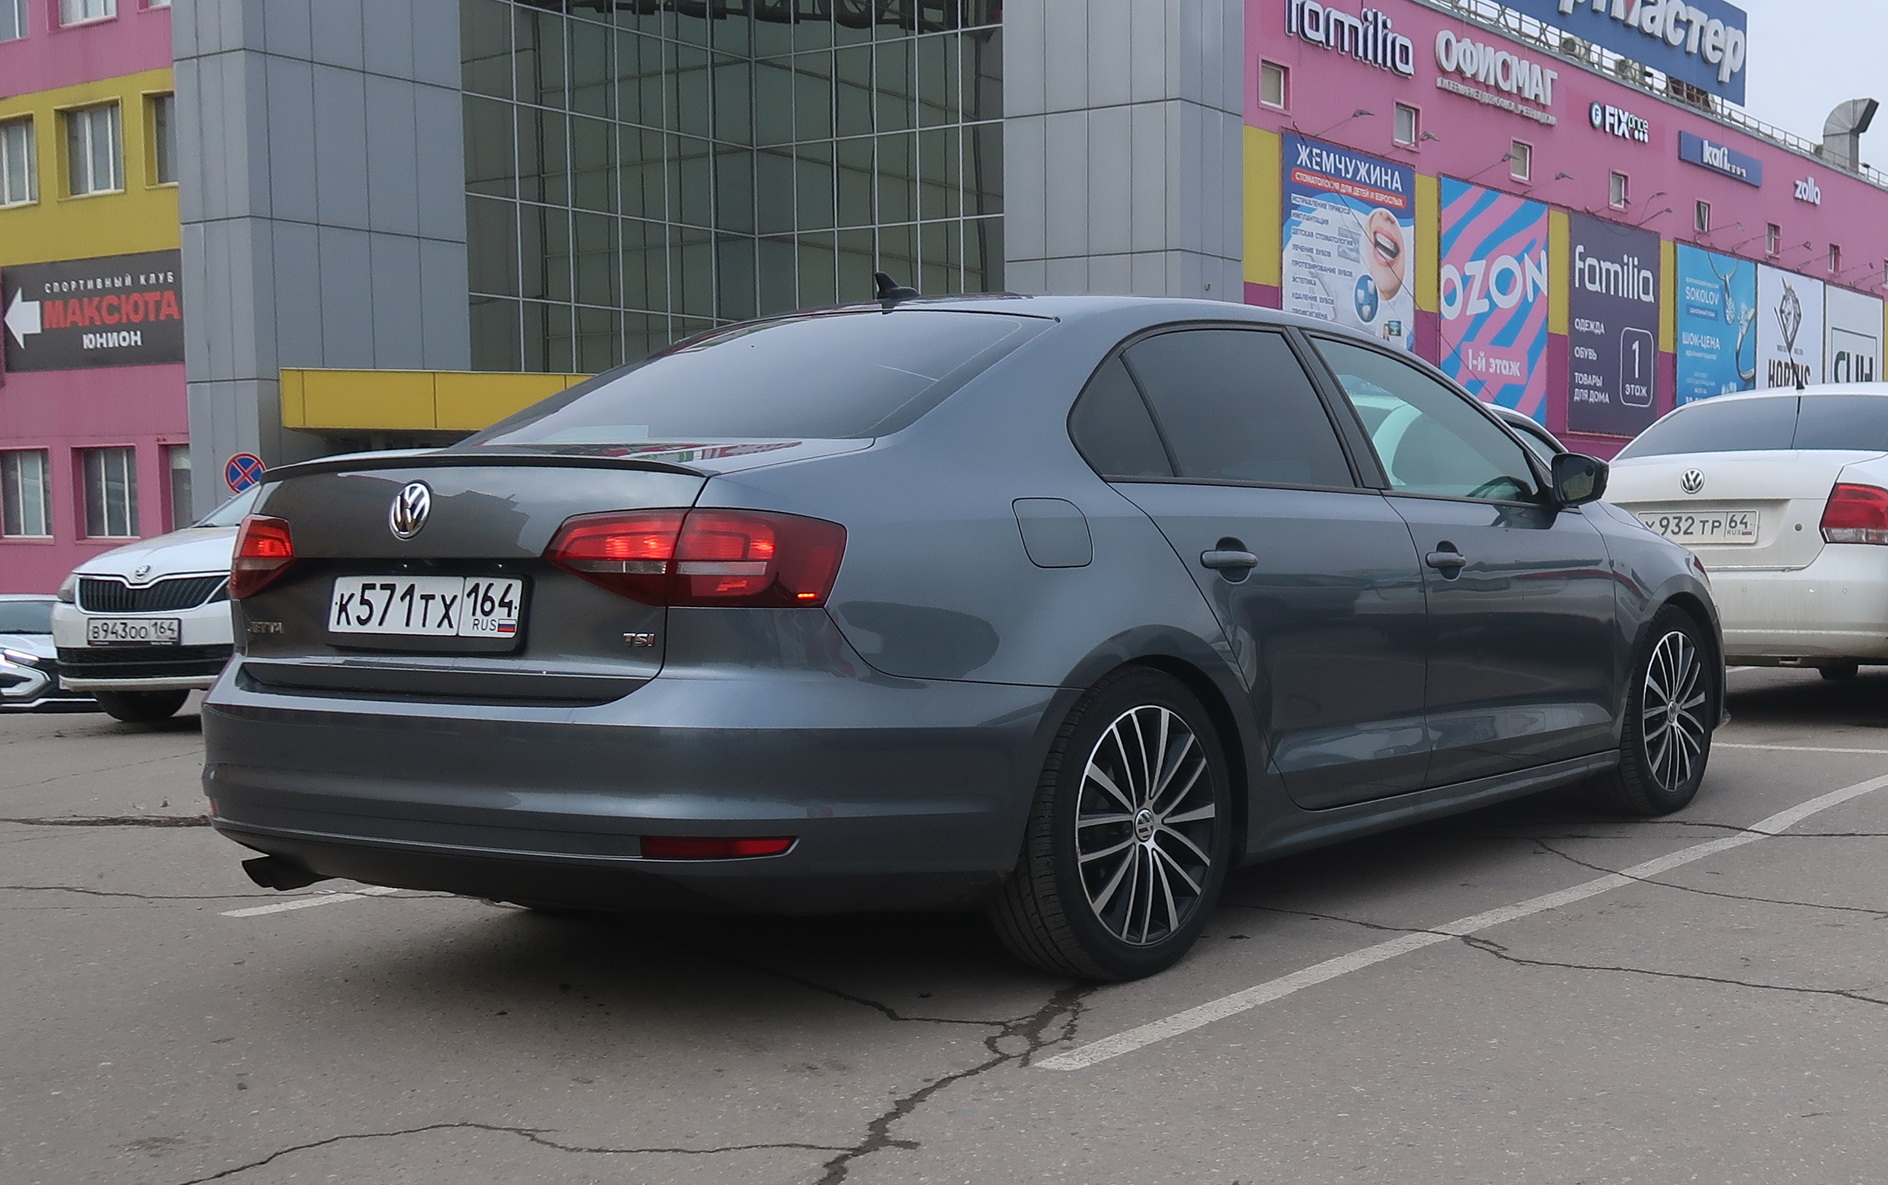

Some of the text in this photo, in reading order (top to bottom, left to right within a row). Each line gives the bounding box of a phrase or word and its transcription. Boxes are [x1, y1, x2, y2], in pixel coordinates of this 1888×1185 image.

[1436, 30, 1558, 106] ОФИСМАГ
[1296, 143, 1402, 192] ЖЕМЧУЖИНА
[1295, 172, 1339, 190] СТОМАТОЛОГИЯ
[1341, 184, 1352, 195] ДЛЯ
[1353, 186, 1369, 198] ДЕТЕЙ
[1375, 192, 1403, 206] ВЗРОСЛЫХ
[1794, 177, 1820, 205] zolla
[45, 272, 174, 293] СПОРТИВНЫЙ КЛУБ
[1575, 245, 1654, 303] familia
[1441, 250, 1547, 320] OZON
[1686, 287, 1720, 305] SOKOLOV
[44, 291, 181, 329] МАКСЮТА
[1575, 318, 1605, 334] ОДЕЖДА
[83, 330, 142, 350] ЮНИОН
[1683, 332, 1720, 350] ШОК-ЦЕНА
[1468, 349, 1520, 376] 1-й этаж
[1575, 347, 1597, 360] ОБУВЬ
[1632, 340, 1639, 378] 1
[1575, 372, 1603, 387] ТОВАРЫ
[1574, 389, 1610, 404] ДЛЯ ДОМА
[1626, 384, 1647, 397] этаж
[467, 583, 513, 618] 164
[152, 622, 176, 635] 164
[472, 618, 496, 631] RUS
[623, 633, 655, 647] TSI
